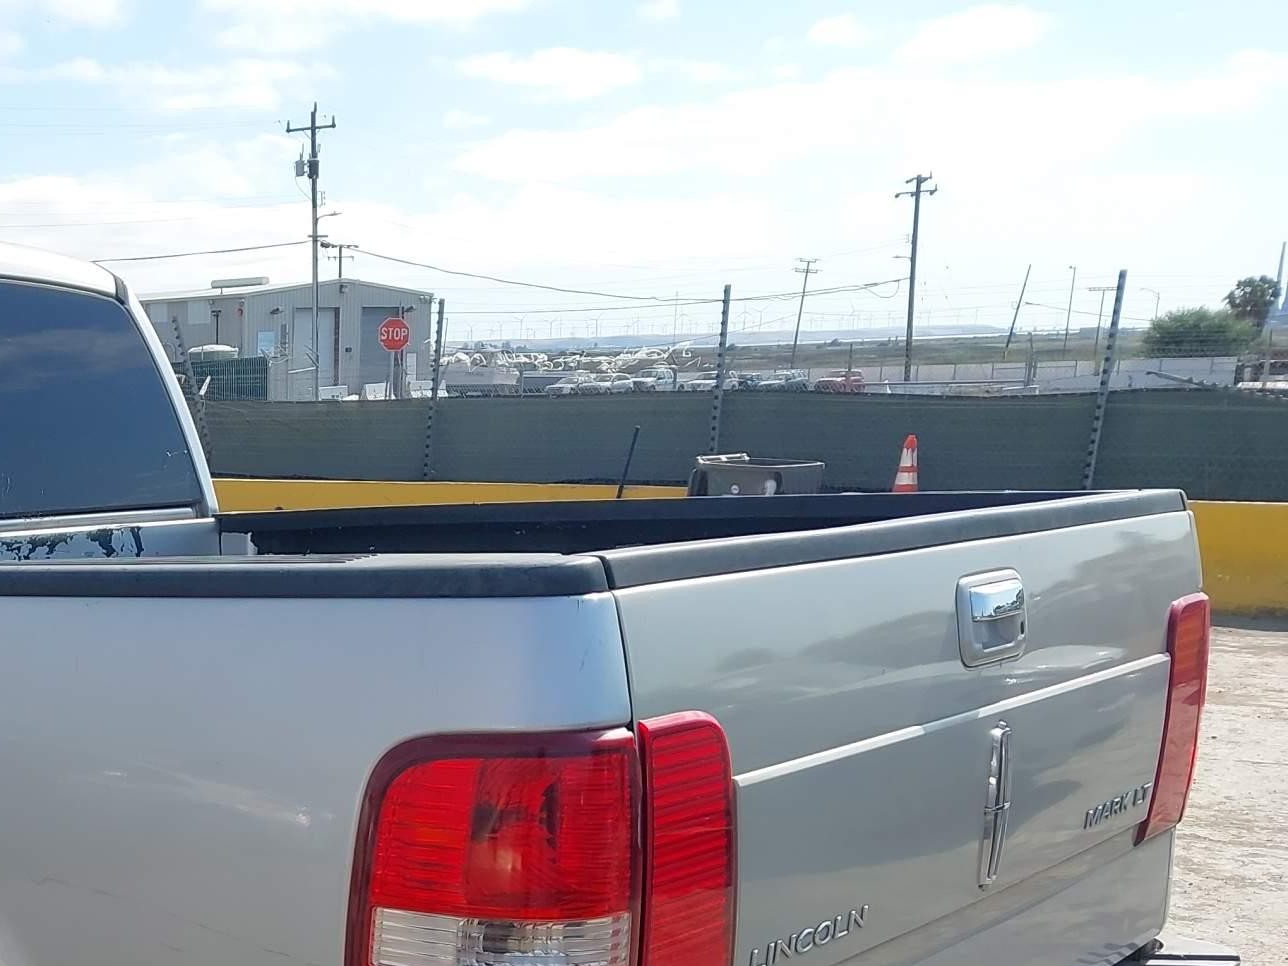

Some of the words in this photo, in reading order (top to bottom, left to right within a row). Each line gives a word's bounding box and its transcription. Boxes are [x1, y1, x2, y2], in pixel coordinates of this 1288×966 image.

[381, 327, 408, 340] STOP
[1083, 791, 1132, 830] MARK
[1132, 782, 1153, 807] LT
